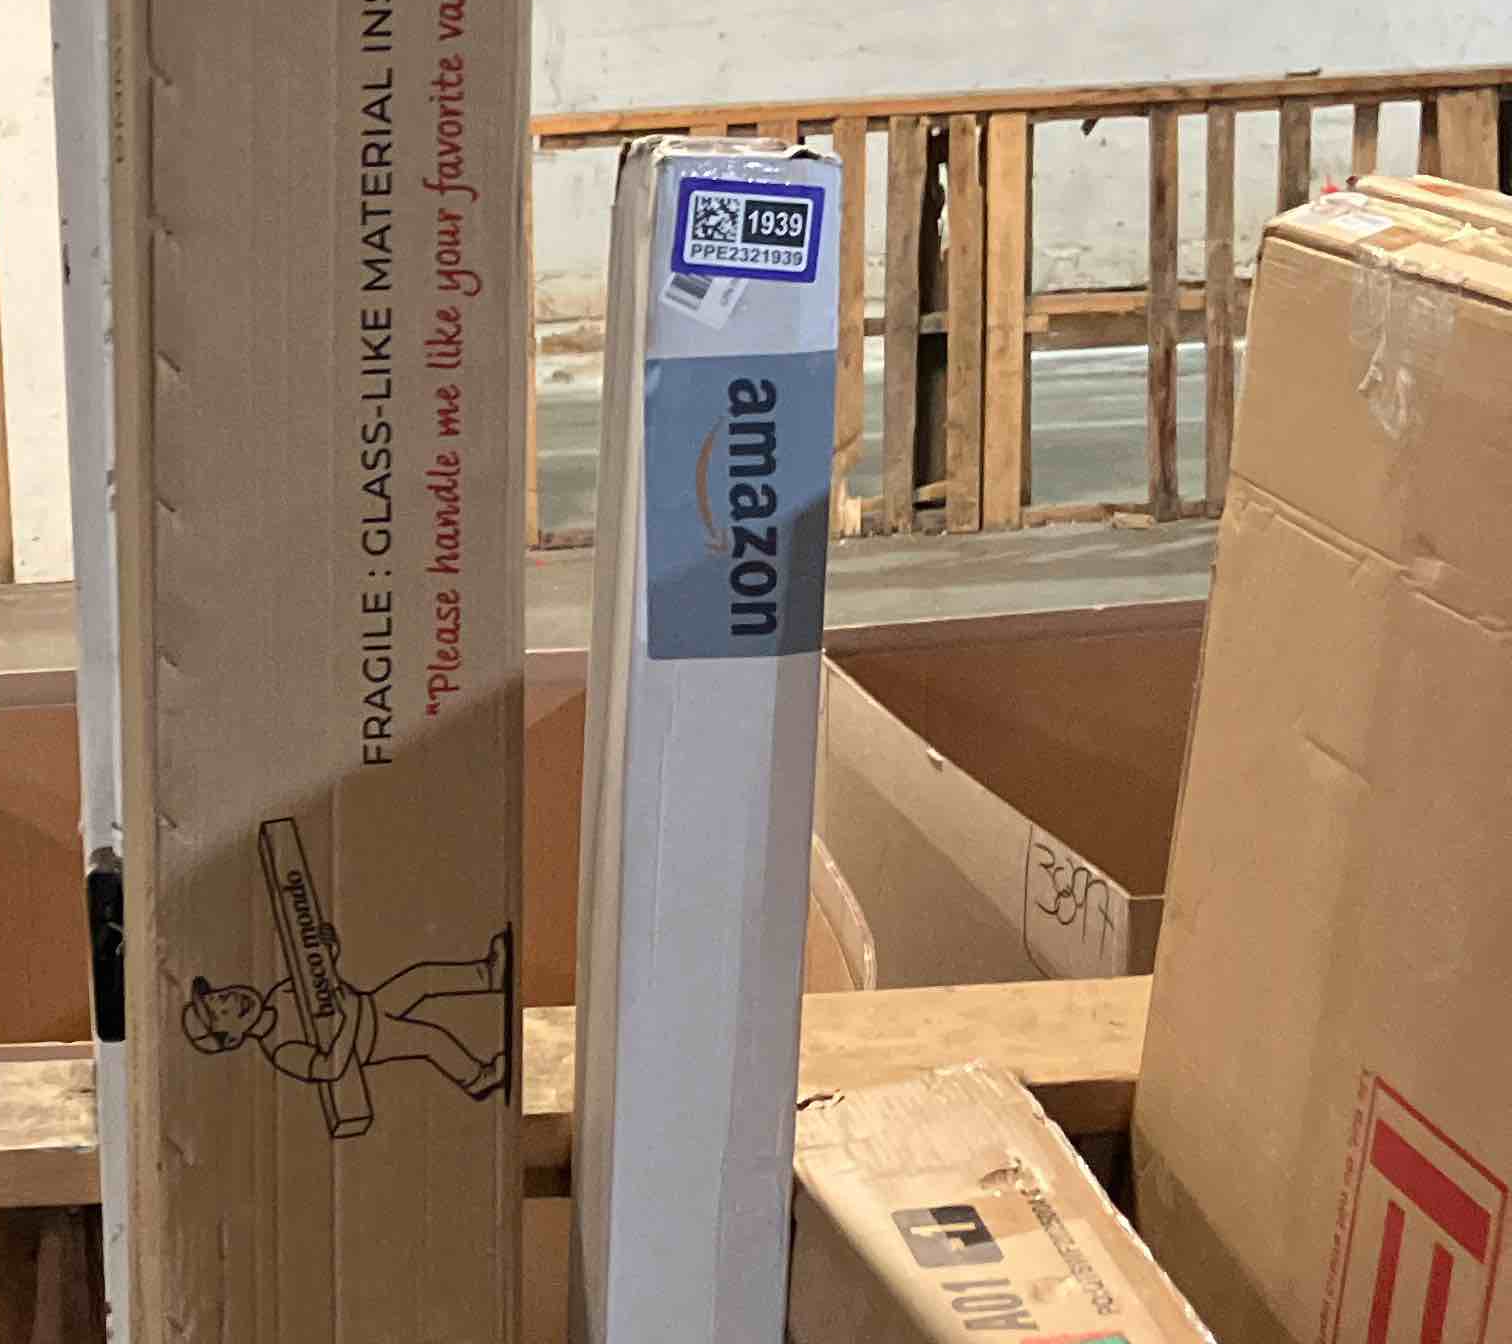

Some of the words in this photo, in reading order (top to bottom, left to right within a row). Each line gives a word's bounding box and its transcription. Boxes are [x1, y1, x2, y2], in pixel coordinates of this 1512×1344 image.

[361, 67, 393, 292] MATERIAL
[422, 53, 479, 202] favorite
[435, 207, 483, 296] your
[690, 243, 804, 267] PPE2321939
[747, 209, 805, 238] 1939
[424, 304, 463, 371] like
[361, 306, 393, 557] GLASS-LIKE
[435, 383, 462, 437] me
[425, 452, 462, 575] handle
[728, 377, 779, 637] amazon
[361, 590, 393, 767] FRAGILE
[940, 1277, 1041, 1332] A01
